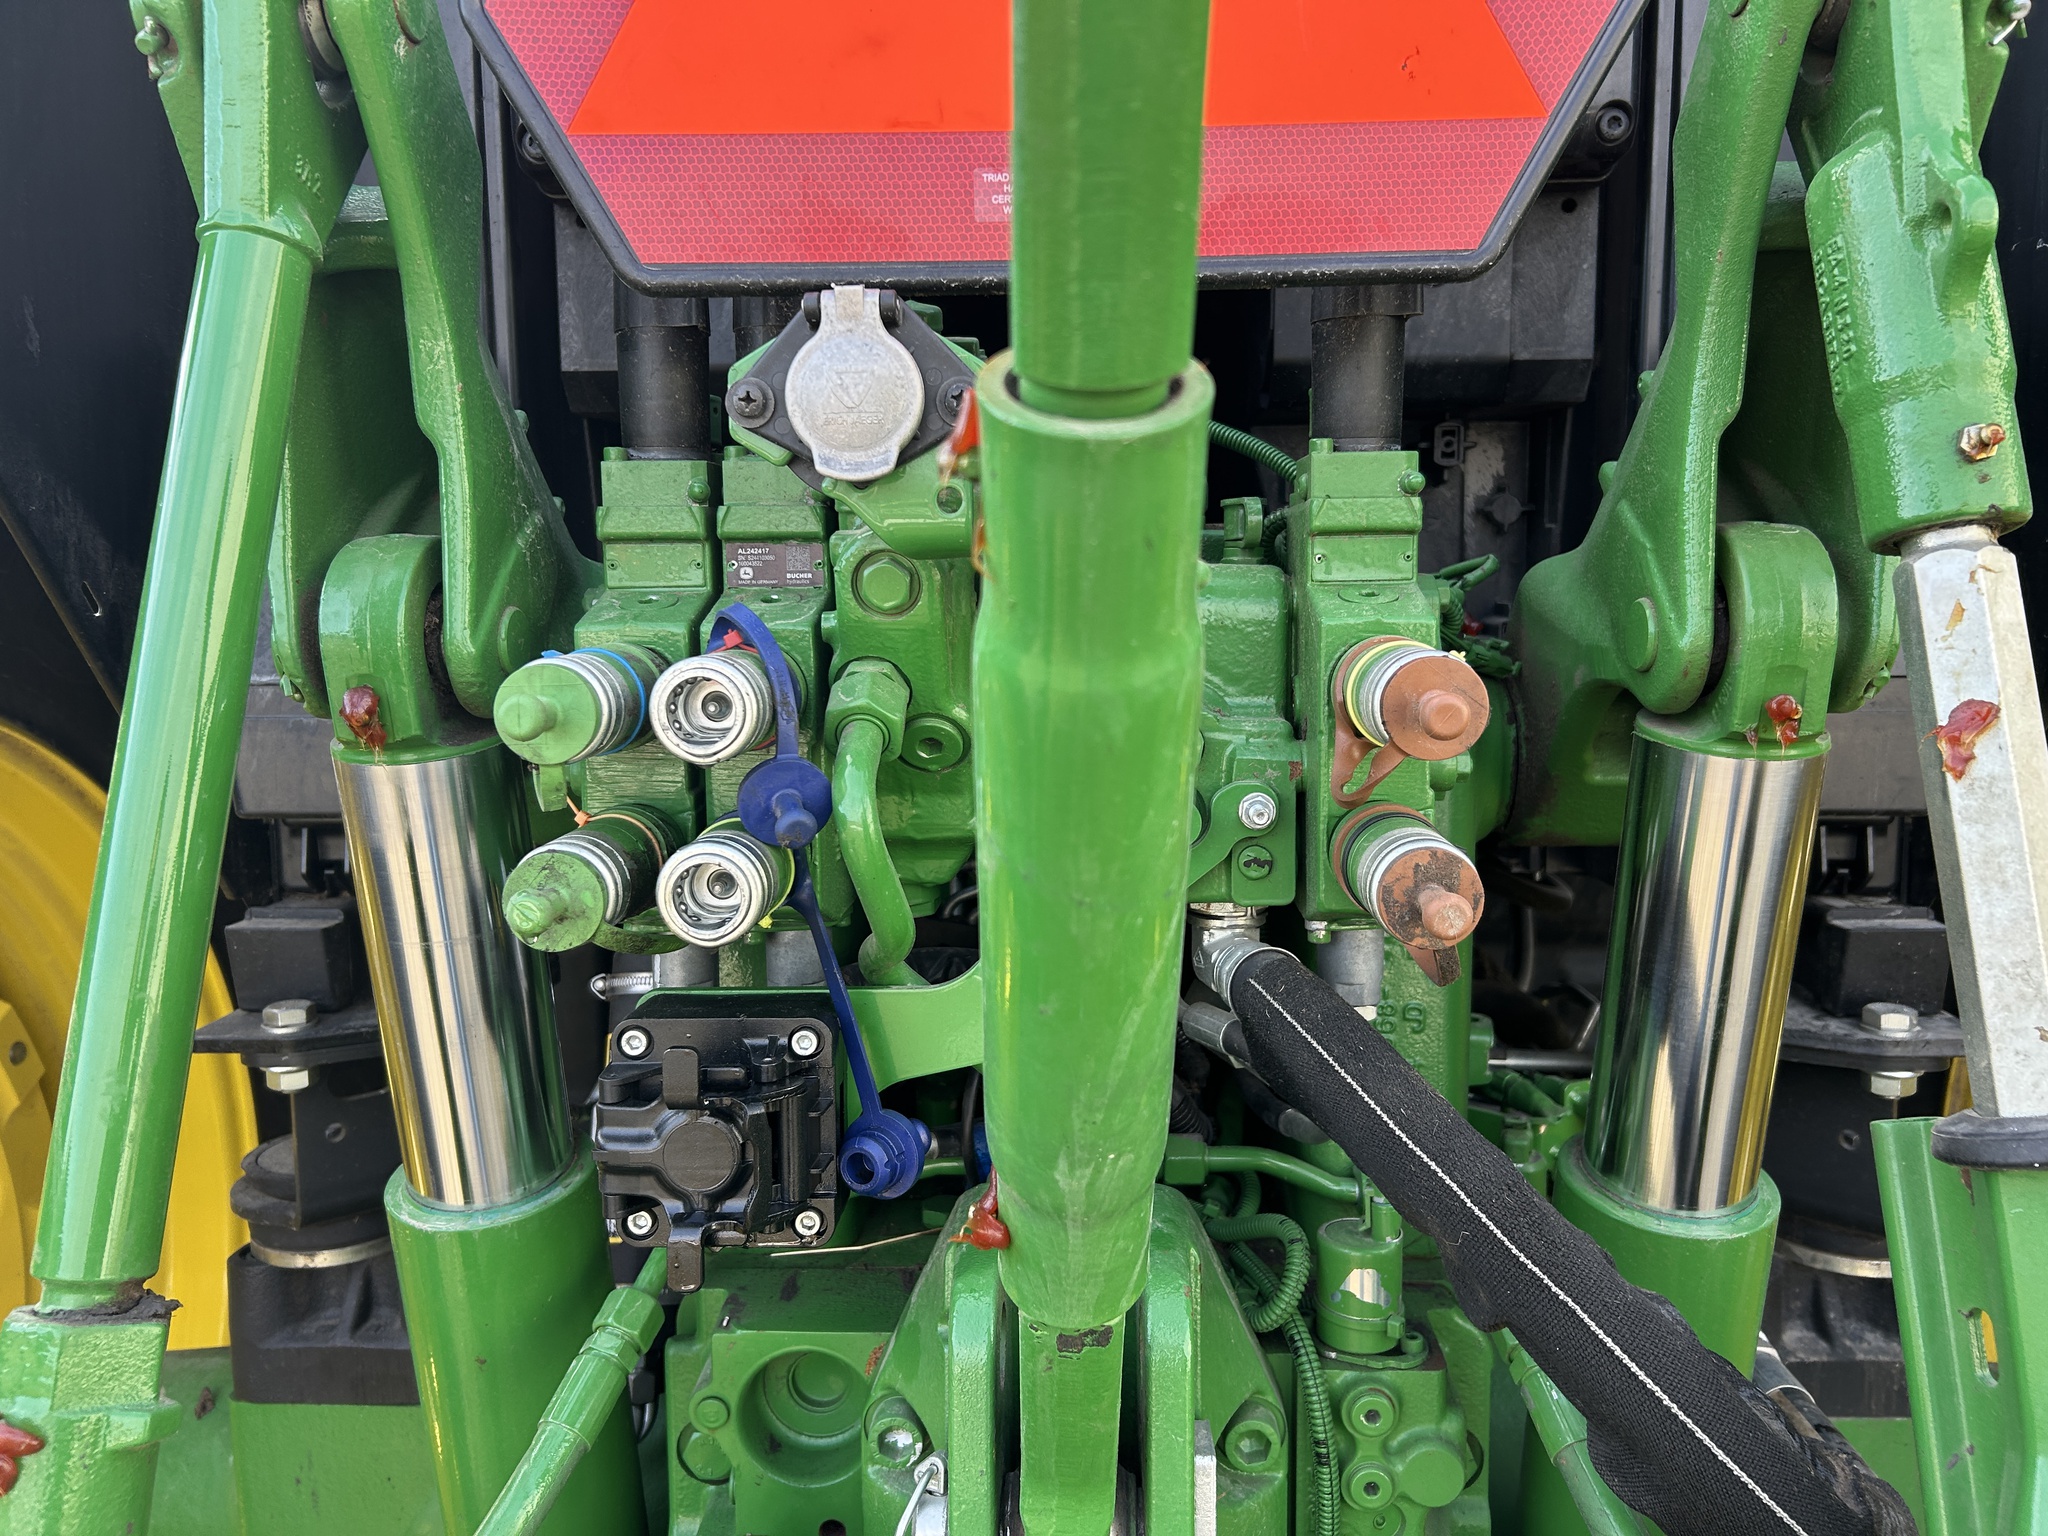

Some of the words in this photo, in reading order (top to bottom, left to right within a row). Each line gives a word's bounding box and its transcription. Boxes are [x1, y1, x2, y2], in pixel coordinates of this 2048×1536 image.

[982, 173, 1009, 182] TRIAD
[823, 415, 848, 425] ERICH
[850, 415, 884, 425] JAEGER
